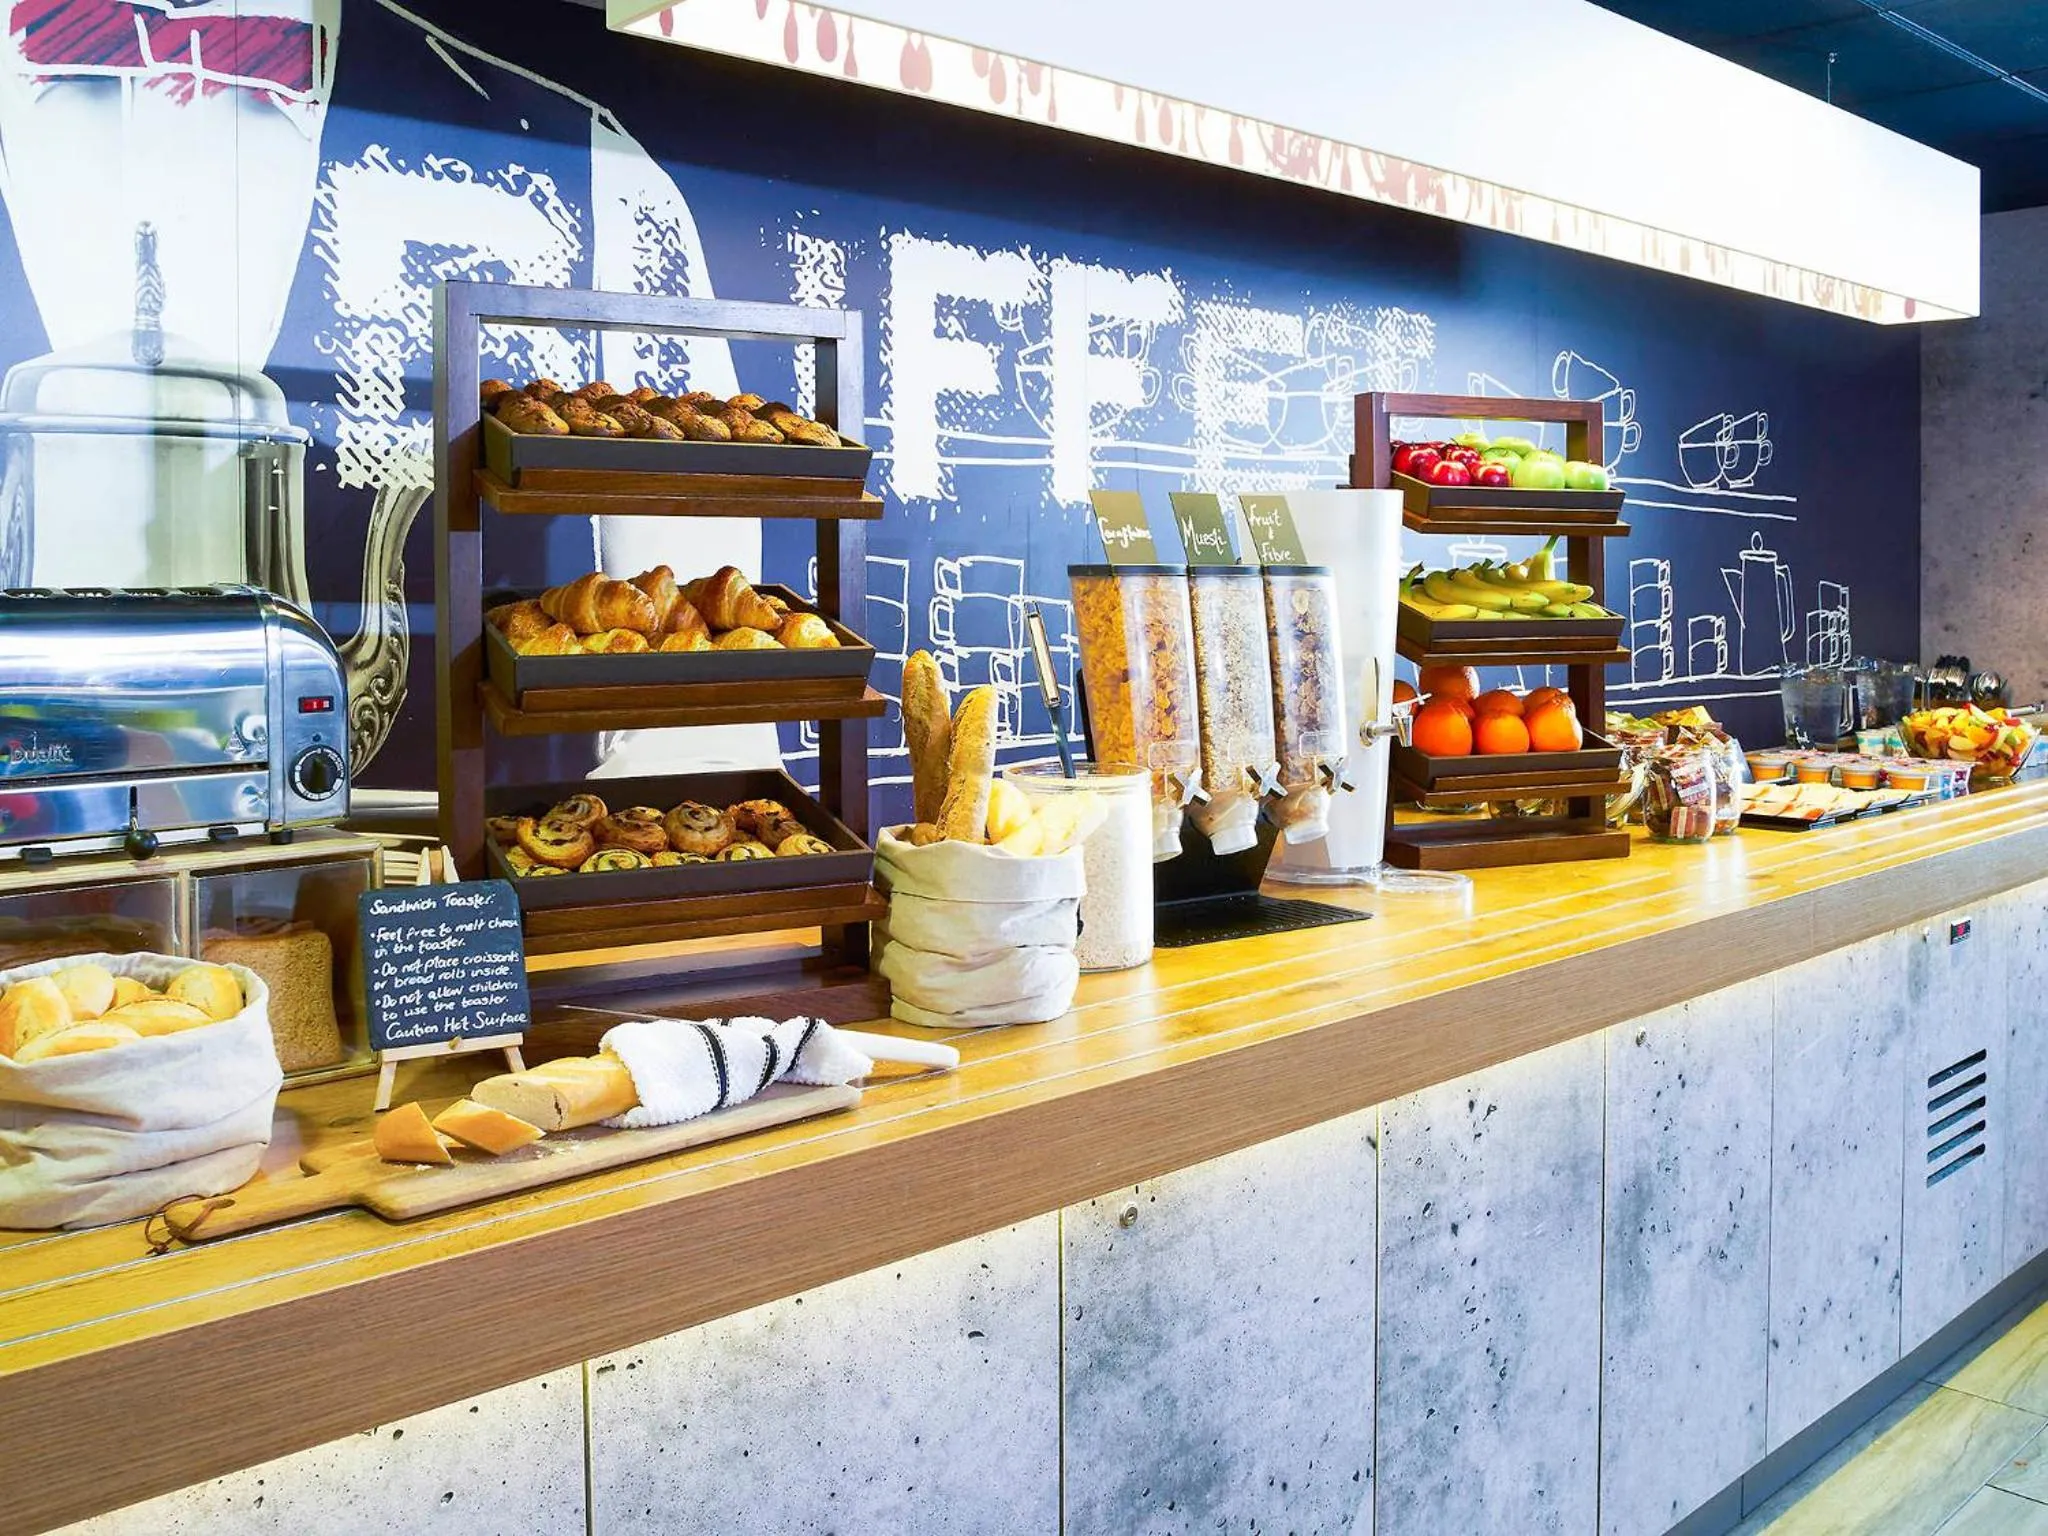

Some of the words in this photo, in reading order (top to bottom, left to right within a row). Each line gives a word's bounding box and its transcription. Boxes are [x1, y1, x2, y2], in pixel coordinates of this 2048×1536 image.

[1249, 504, 1282, 527] Fruit
[1181, 515, 1227, 556] Muesli
[369, 898, 437, 916] Sandwich
[376, 926, 403, 943] Feel
[406, 926, 436, 941] free
[439, 922, 451, 936] to
[456, 919, 486, 933] melt
[374, 945, 388, 959] in
[393, 941, 415, 953] the
[381, 962, 398, 977] Do
[402, 958, 423, 974] not
[424, 955, 460, 973] place
[463, 950, 520, 965] croissants
[373, 980, 387, 991] or
[394, 973, 434, 988] bread
[438, 968, 466, 981] rolls
[381, 994, 396, 1009] Do
[399, 989, 424, 1005] not
[428, 985, 464, 1000] allow
[469, 979, 518, 993] children
[382, 1011, 398, 1022] to
[404, 1006, 428, 1016] use
[433, 1001, 455, 1012] the
[386, 1022, 439, 1040] Caution
[444, 1016, 470, 1033] Hot
[472, 1011, 528, 1029] Surface
